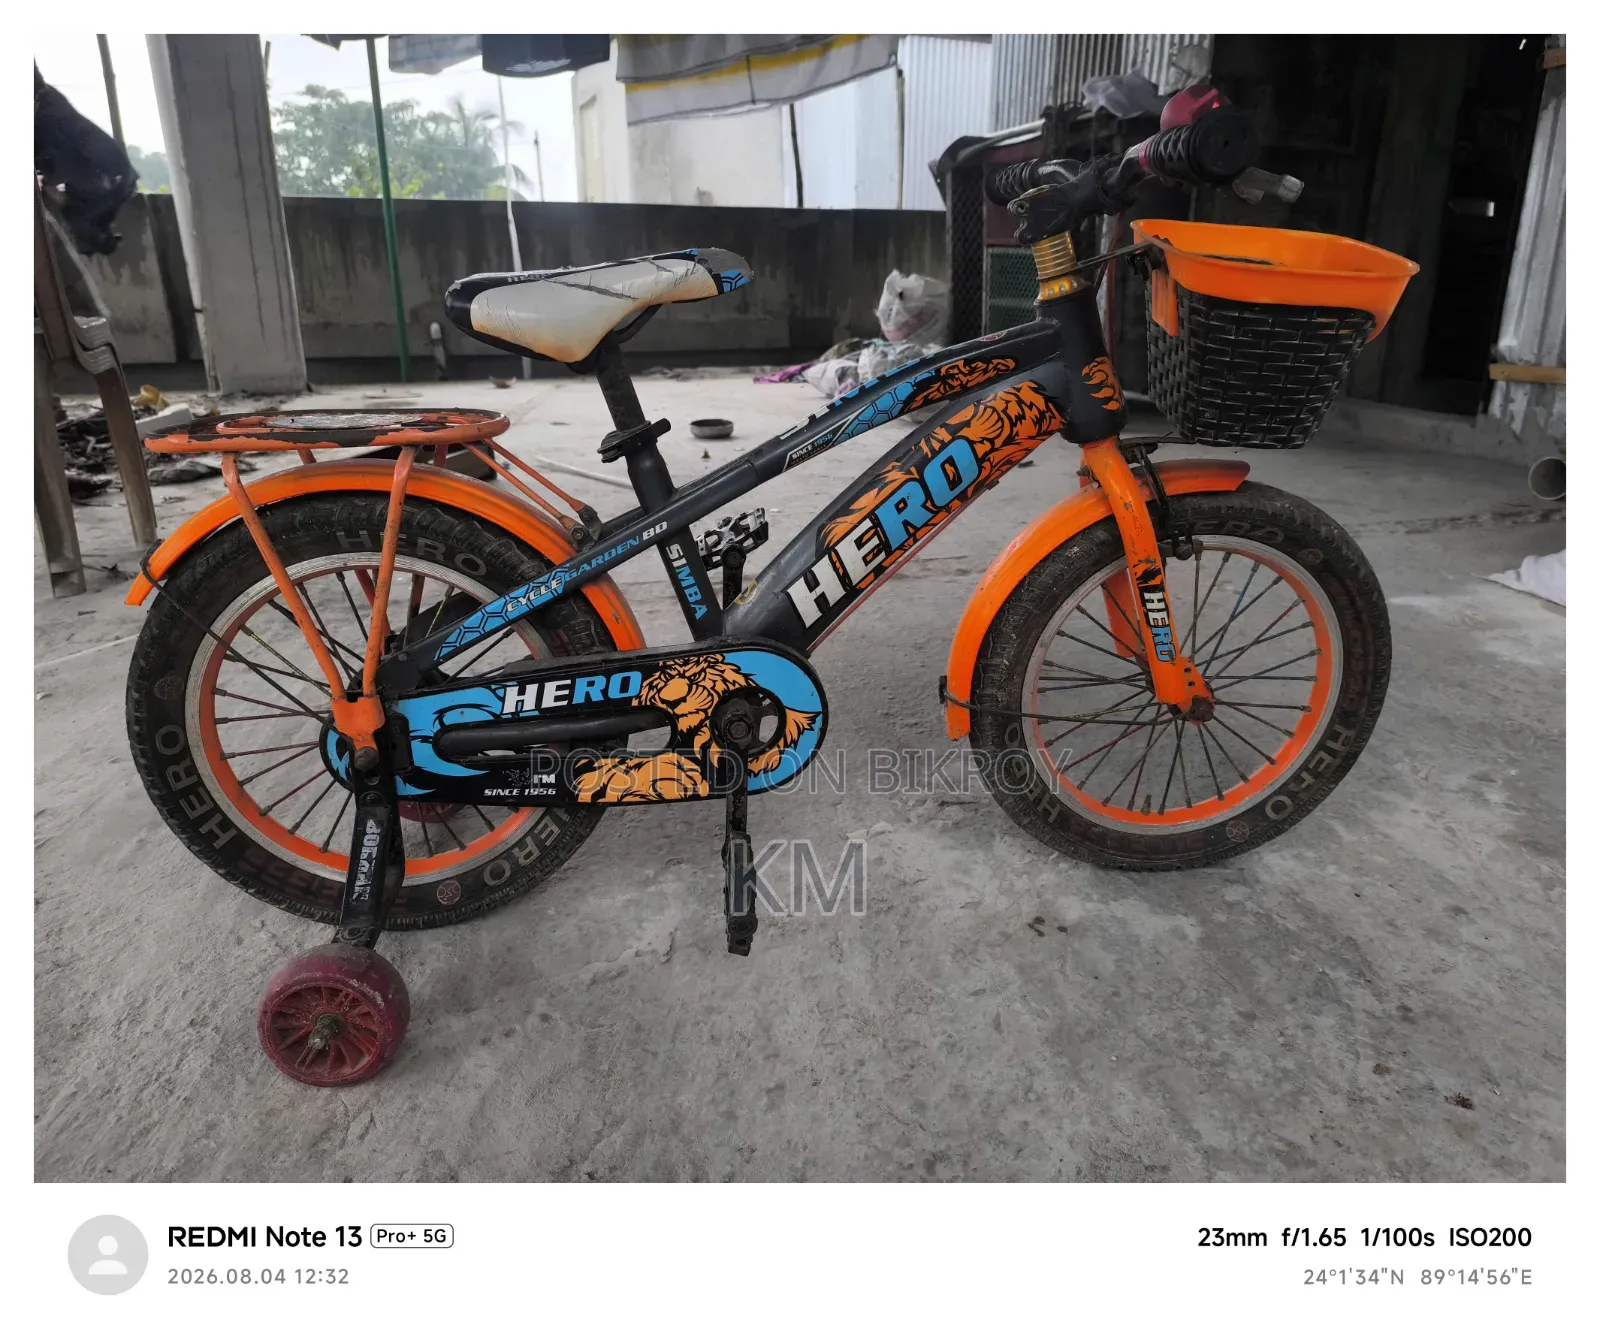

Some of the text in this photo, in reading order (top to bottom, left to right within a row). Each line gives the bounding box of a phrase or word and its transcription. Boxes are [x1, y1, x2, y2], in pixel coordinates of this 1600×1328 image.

[791, 444, 813, 460] SINCE
[336, 530, 487, 576] HERO
[506, 521, 668, 613] CYCLE GARDEN BD
[786, 438, 979, 629] HERO
[666, 543, 708, 620] SIMBA
[1143, 592, 1177, 662] HERO
[503, 671, 643, 714] HERO
[155, 724, 238, 850] HERO
[483, 787, 557, 797] SINCE 1956
